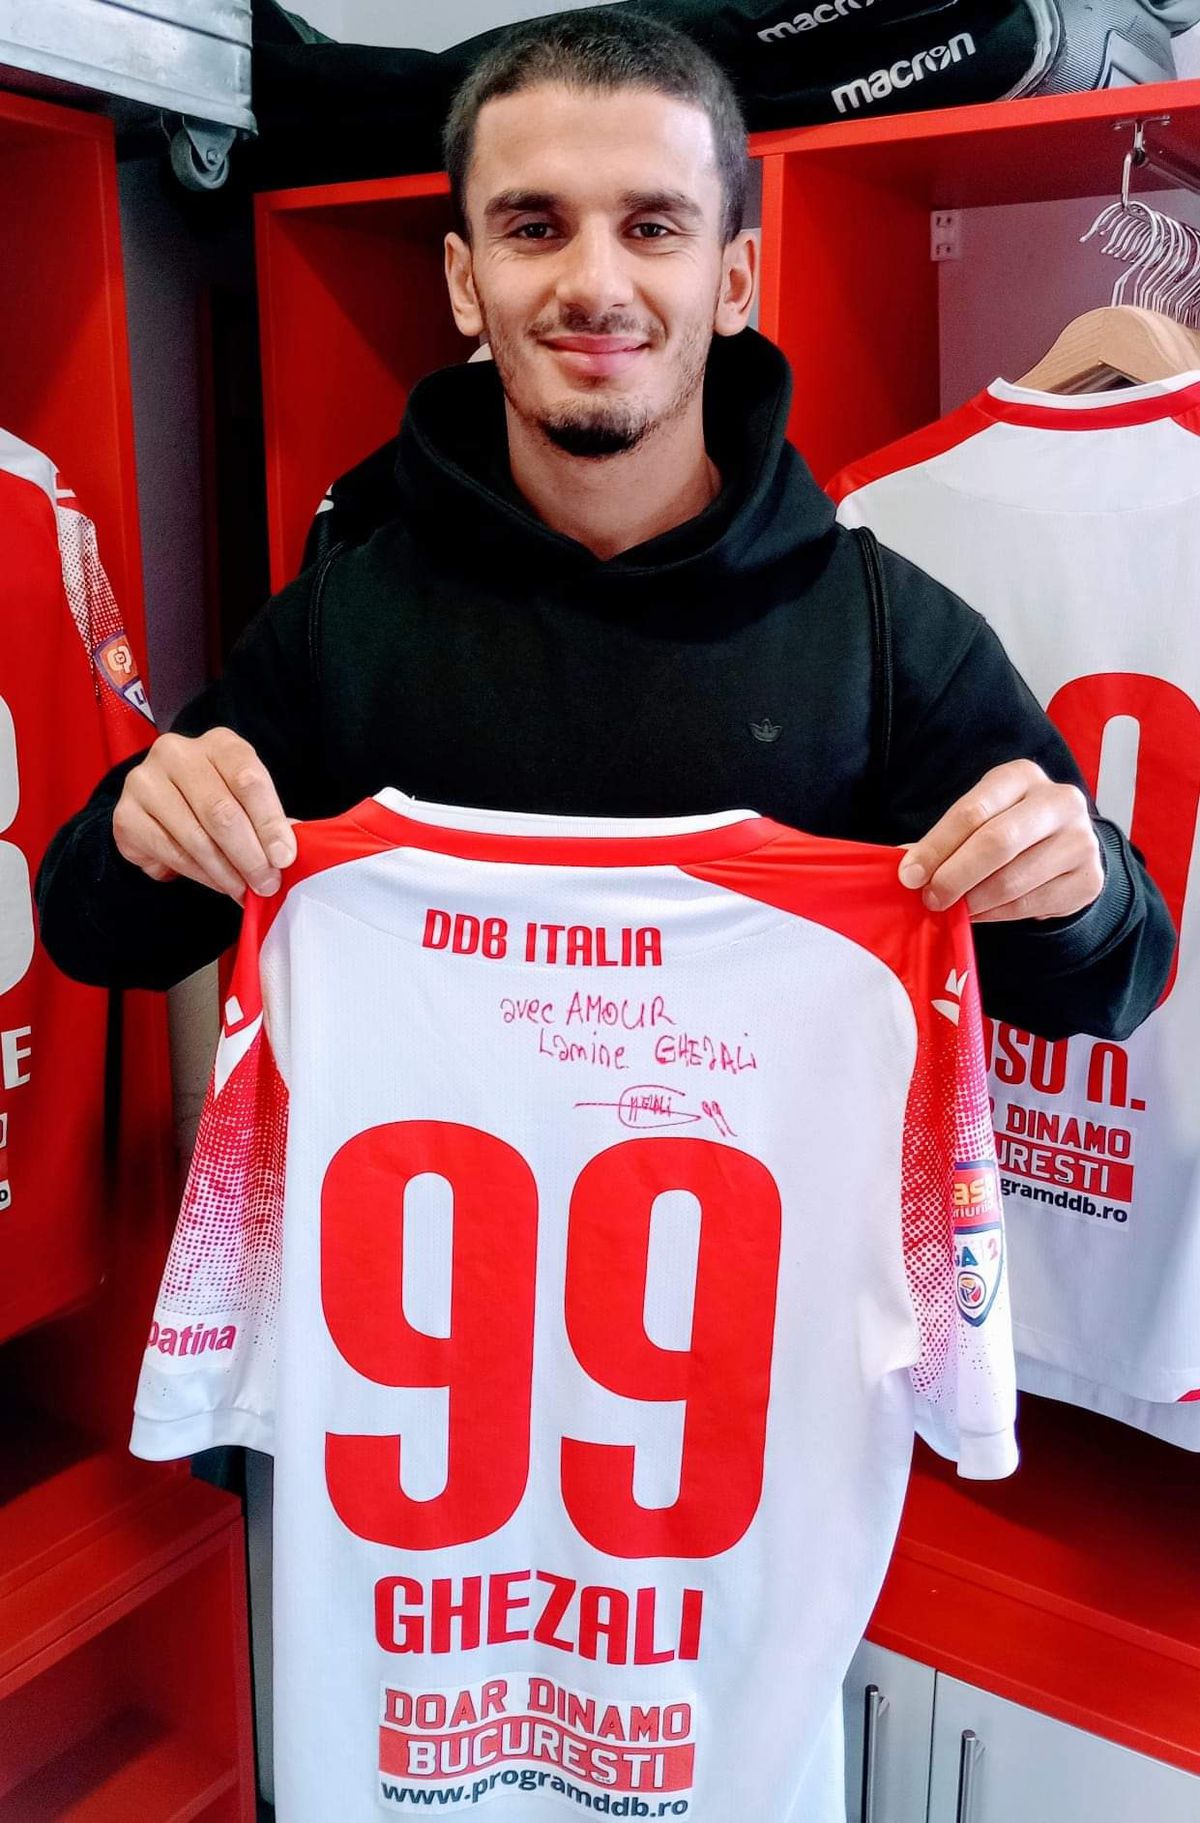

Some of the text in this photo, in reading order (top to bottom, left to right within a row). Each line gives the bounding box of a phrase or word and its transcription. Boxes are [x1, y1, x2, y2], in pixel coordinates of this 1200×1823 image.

[831, 32, 976, 113] macron
[422, 908, 662, 967] DDB ITALIA
[500, 991, 677, 1029] avec AMOUR
[1006, 1103, 1131, 1159] DINAMO
[320, 1119, 782, 1558] 99
[374, 1570, 703, 1665] GHEZALI
[385, 1677, 691, 1742] DOAR DINAMO
[407, 1716, 666, 1789] BUCURESTI
[382, 1769, 689, 1818] www.programddb.ro
